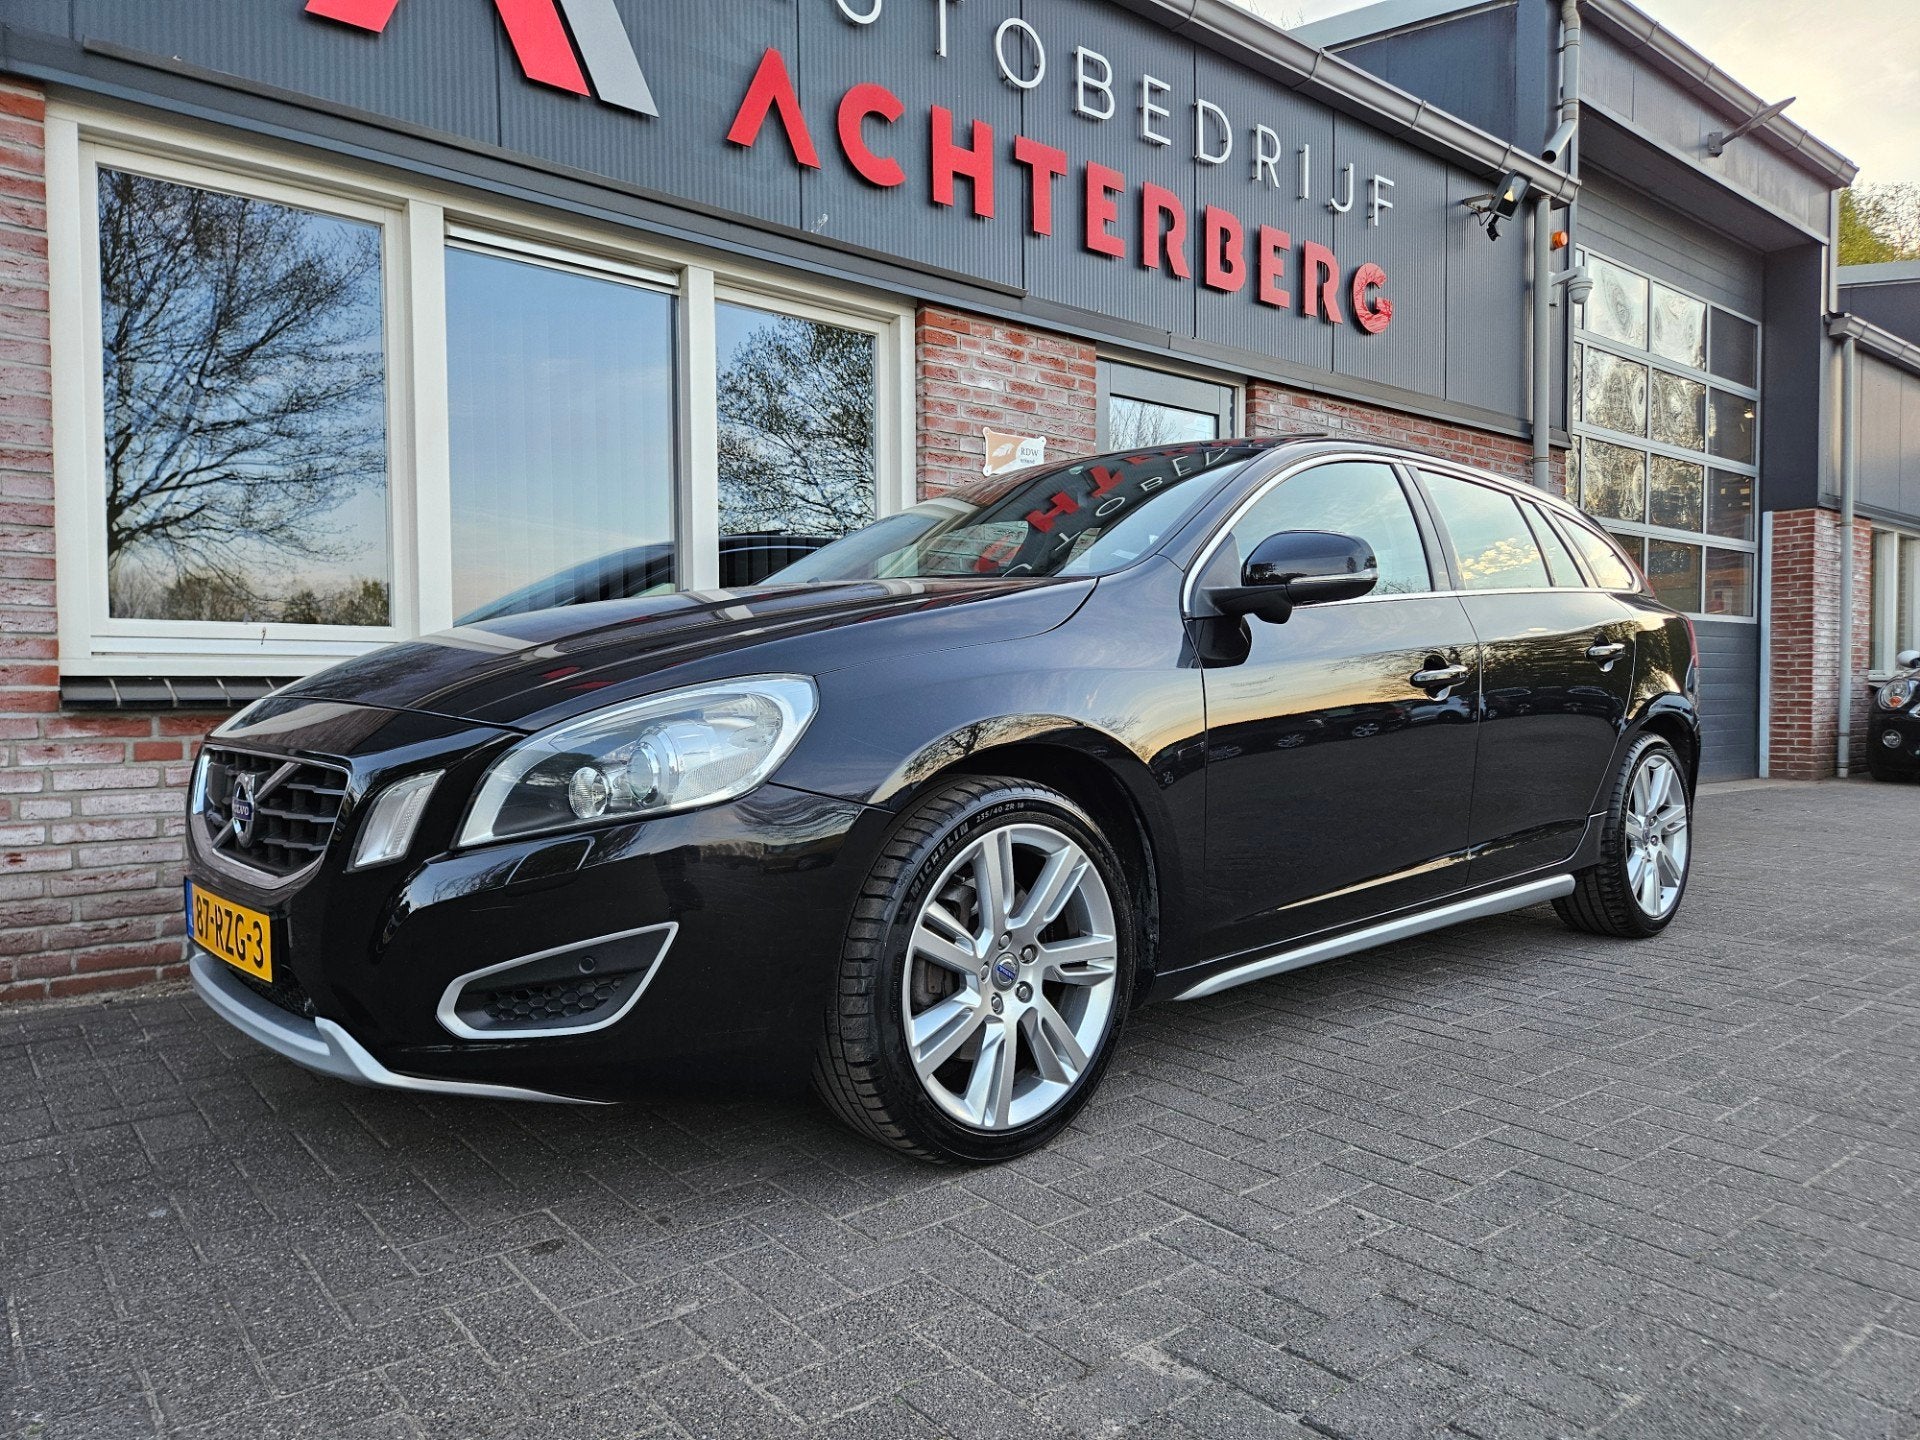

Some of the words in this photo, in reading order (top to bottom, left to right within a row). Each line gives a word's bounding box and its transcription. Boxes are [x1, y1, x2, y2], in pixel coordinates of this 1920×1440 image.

[726, 47, 1393, 335] ACHTERBERG
[1020, 447, 1039, 457] RDW
[910, 821, 969, 898] MICHELIN
[976, 805, 1003, 823] 235/40
[1005, 803, 1015, 811] ZR
[196, 894, 264, 969] 87-RZG-3
